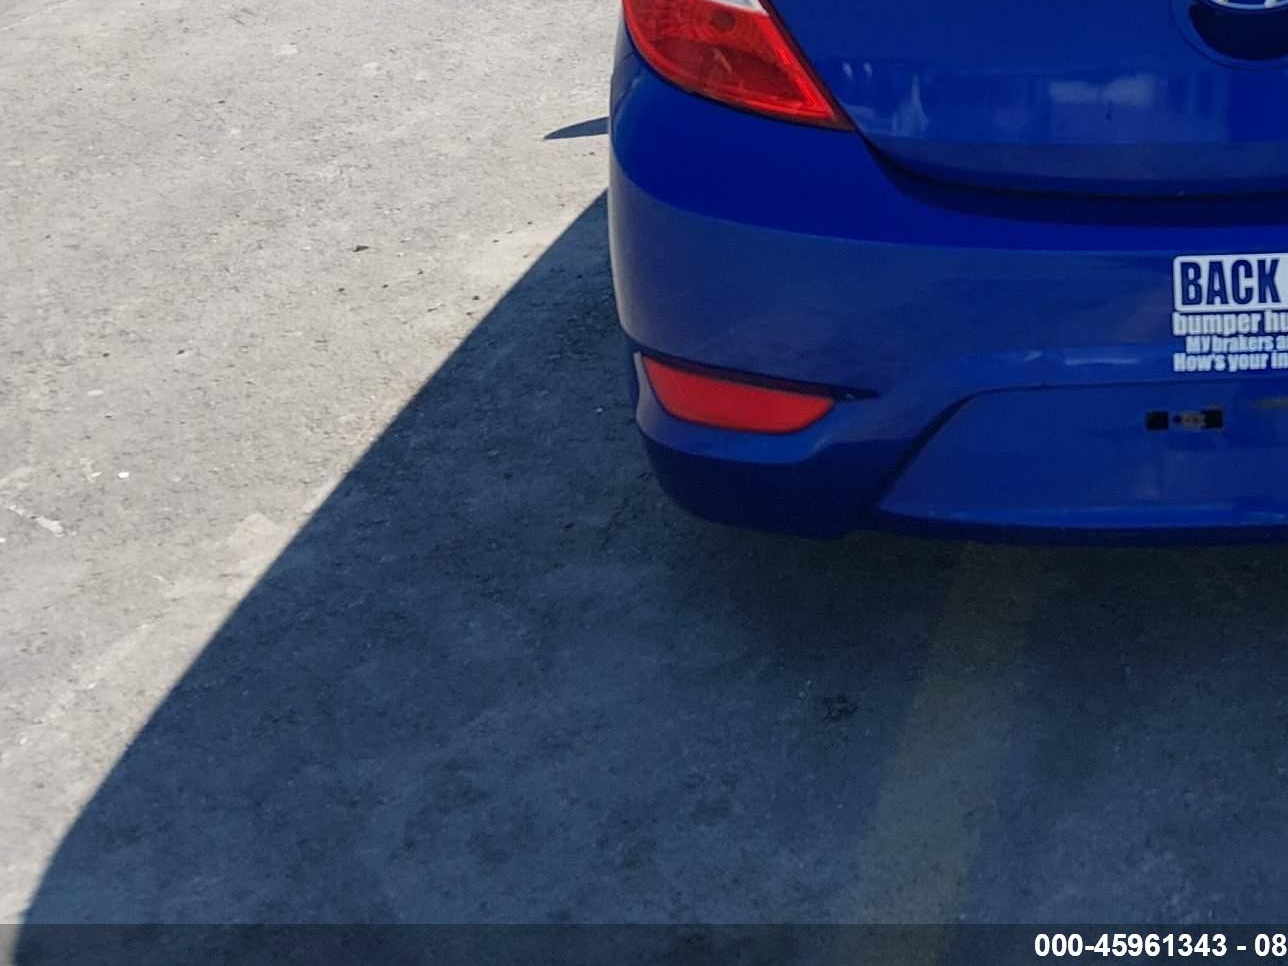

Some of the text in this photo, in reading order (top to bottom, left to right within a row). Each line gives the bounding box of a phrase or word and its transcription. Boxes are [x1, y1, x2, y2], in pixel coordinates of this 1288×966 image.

[1180, 259, 1280, 306] BACK
[1172, 312, 1261, 336] bumper
[1212, 334, 1274, 353] brakers
[1173, 352, 1226, 372] How's
[1227, 352, 1269, 372] your
